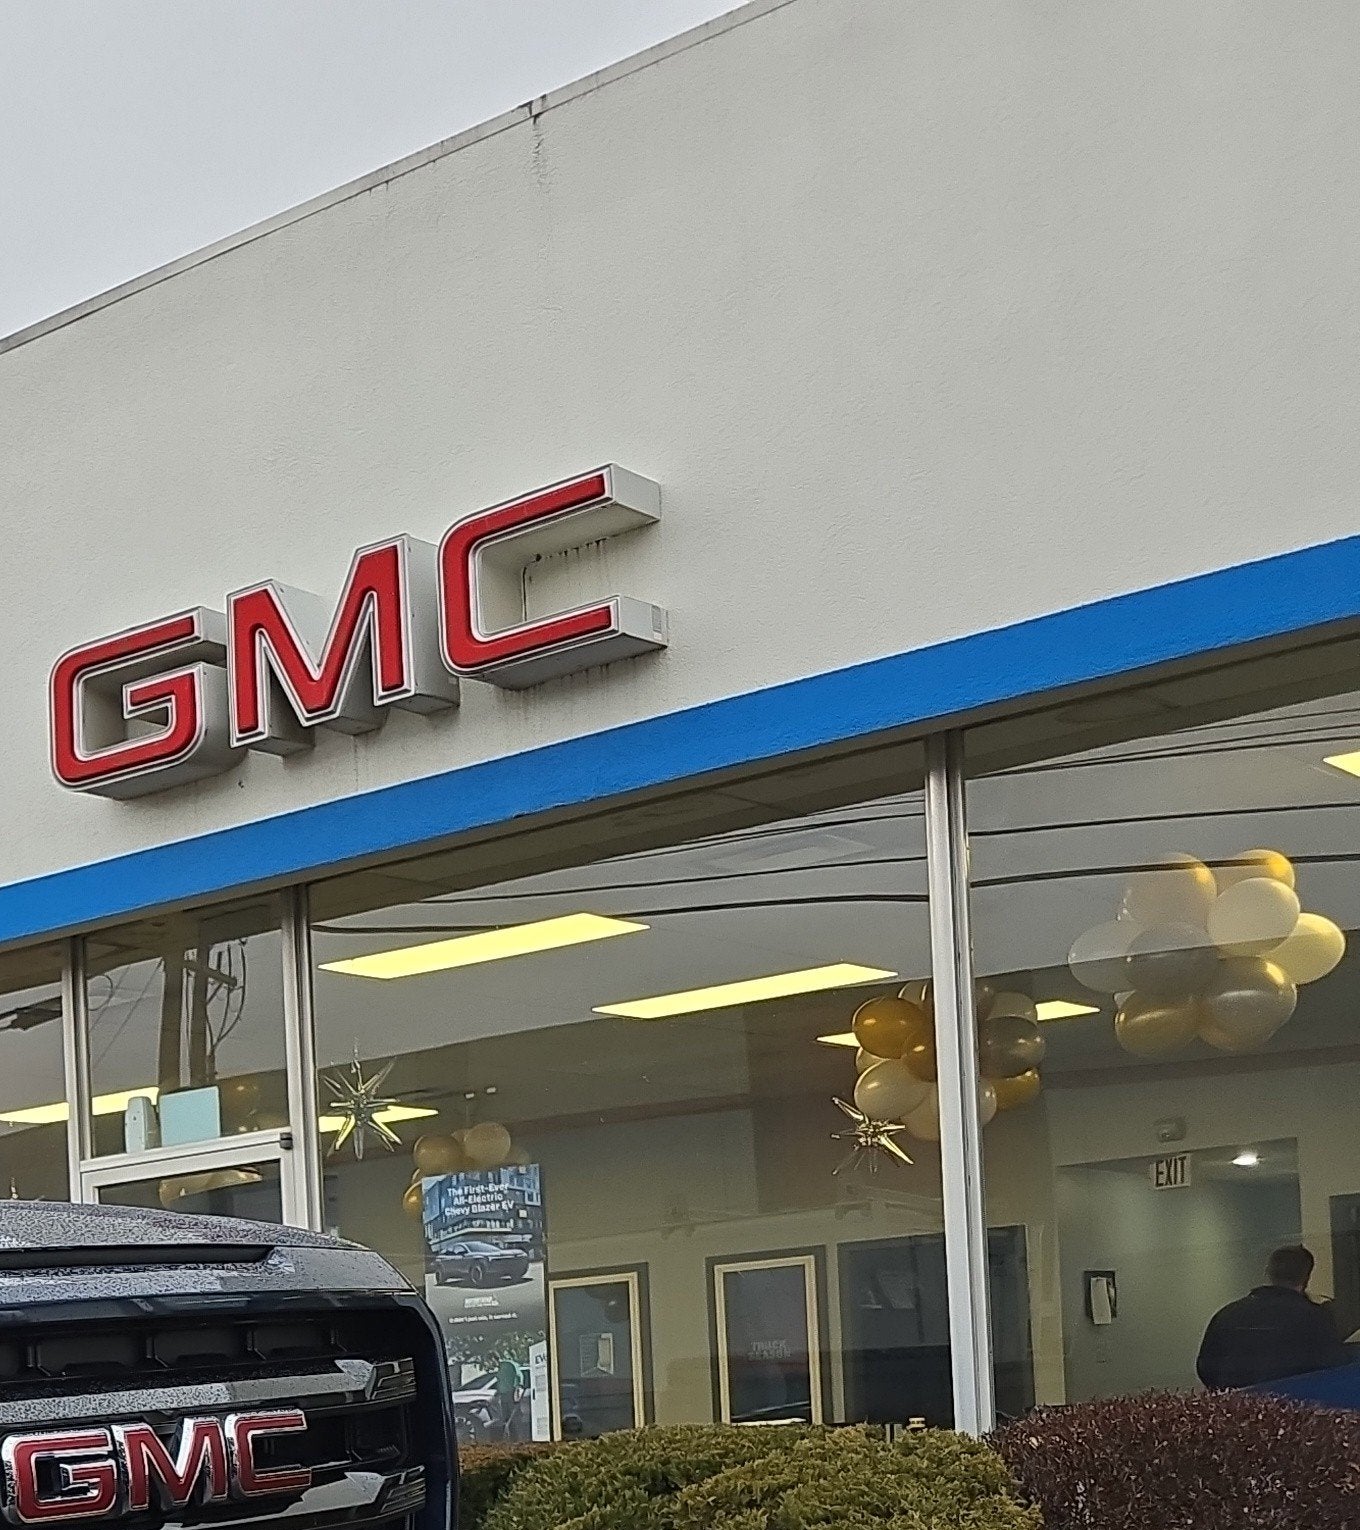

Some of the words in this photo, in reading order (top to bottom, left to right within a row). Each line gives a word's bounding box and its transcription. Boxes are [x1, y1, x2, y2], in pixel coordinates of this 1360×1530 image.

[49, 462, 625, 800] GMC
[1155, 1155, 1187, 1187] EXIT
[447, 1187, 462, 1197] The
[464, 1183, 510, 1195] First-Ever
[453, 1193, 503, 1206] All-Electric
[445, 1205, 470, 1217] Chevy
[471, 1203, 499, 1214] Blazer
[501, 1200, 514, 1210] EV
[0, 1407, 312, 1524] GMC
